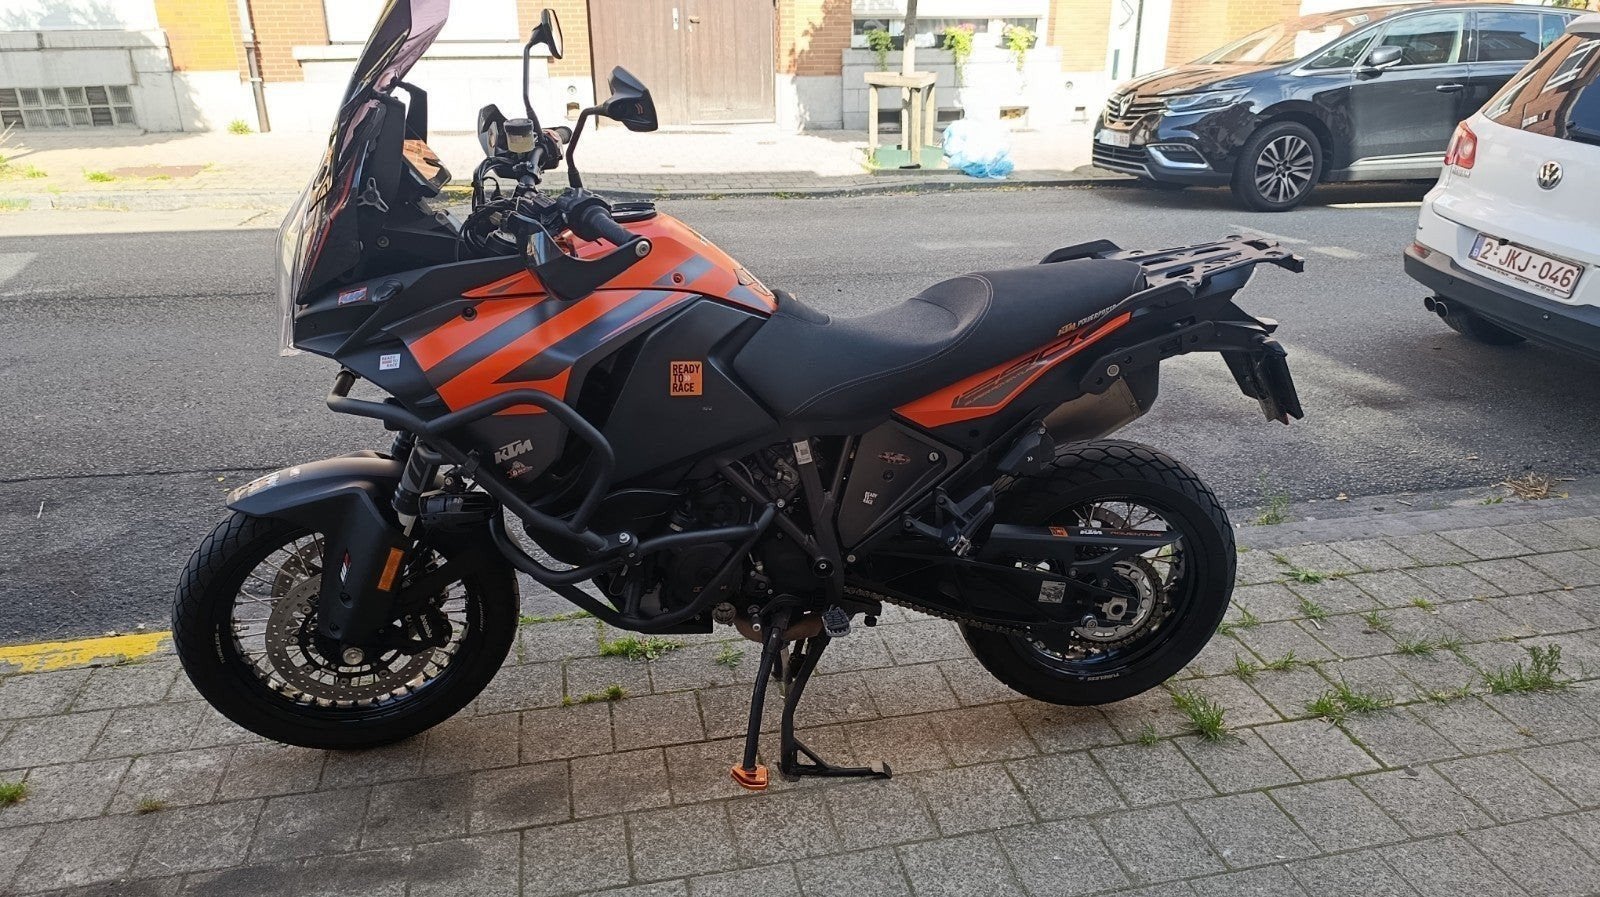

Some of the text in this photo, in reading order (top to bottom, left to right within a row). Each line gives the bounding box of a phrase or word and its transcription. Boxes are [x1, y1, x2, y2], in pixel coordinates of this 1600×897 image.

[672, 364, 700, 374] READY
[673, 374, 684, 383] TO
[672, 383, 695, 392] RACE
[494, 439, 533, 464] KTM
